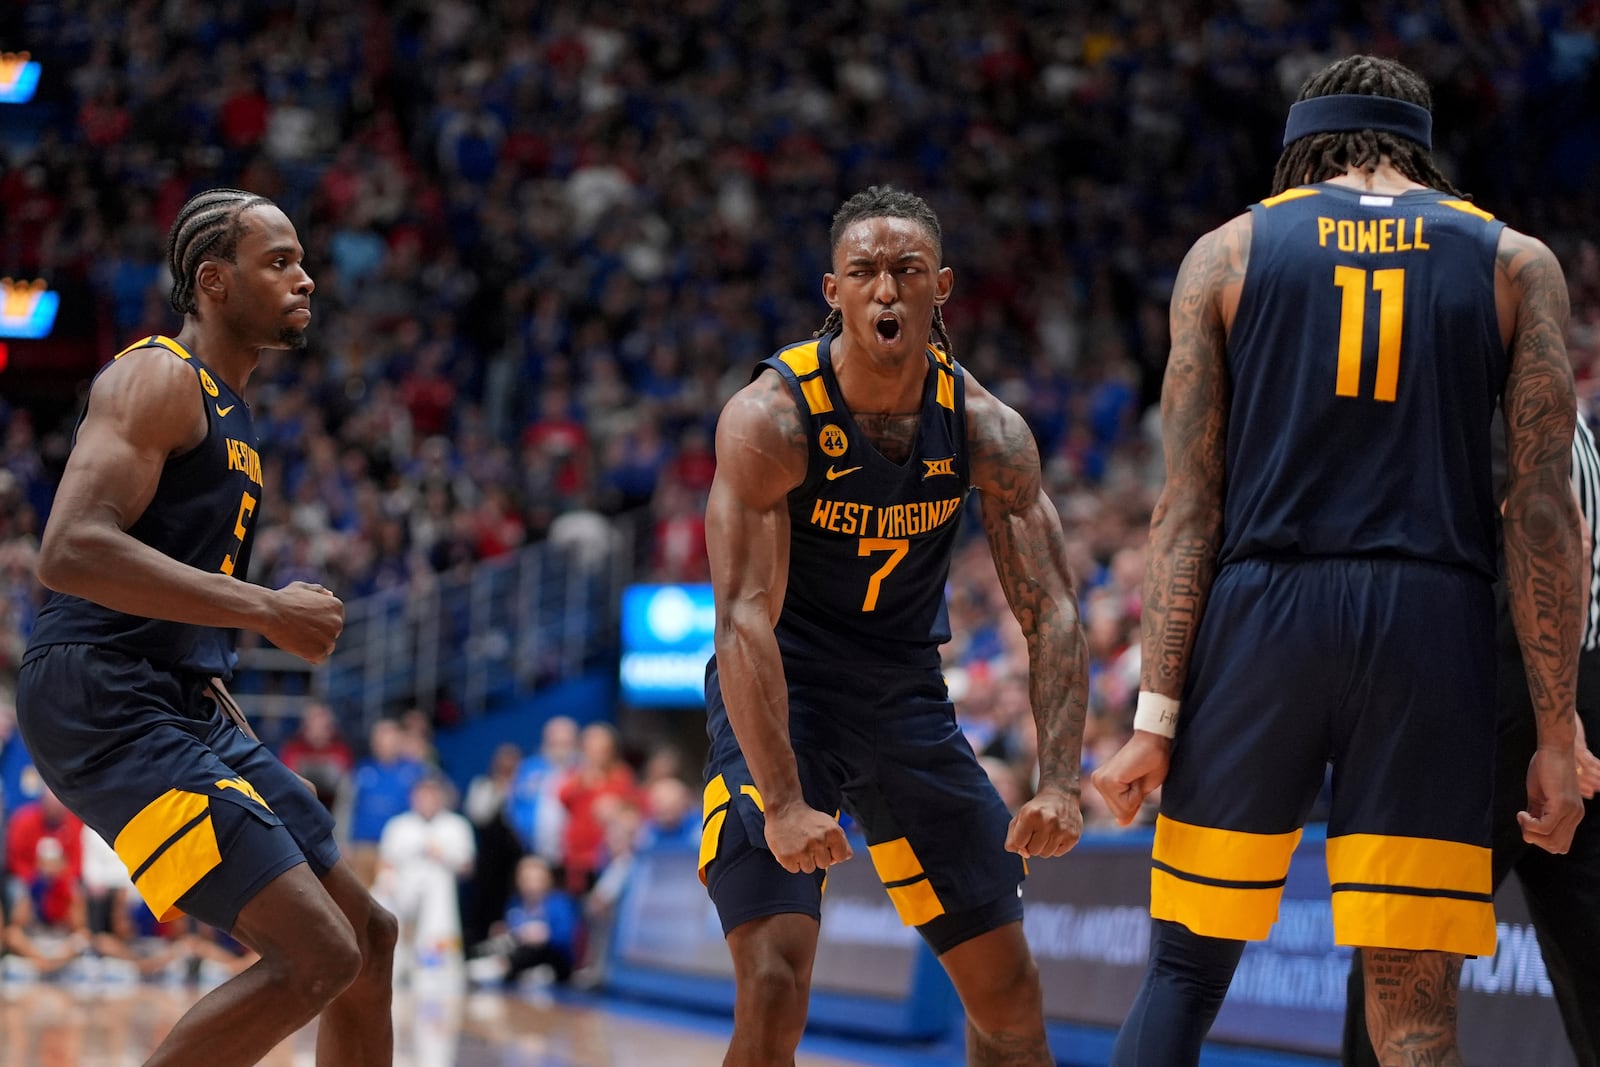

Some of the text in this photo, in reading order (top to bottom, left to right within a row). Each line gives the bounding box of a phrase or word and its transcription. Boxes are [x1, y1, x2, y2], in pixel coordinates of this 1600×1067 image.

[1317, 216, 1430, 254] POWELL
[1333, 265, 1405, 402] 11
[824, 437, 844, 450] 44
[922, 457, 956, 479] XII
[220, 491, 257, 577] 5
[811, 497, 961, 538] WEST VIRGINIA
[857, 537, 910, 612] 7
